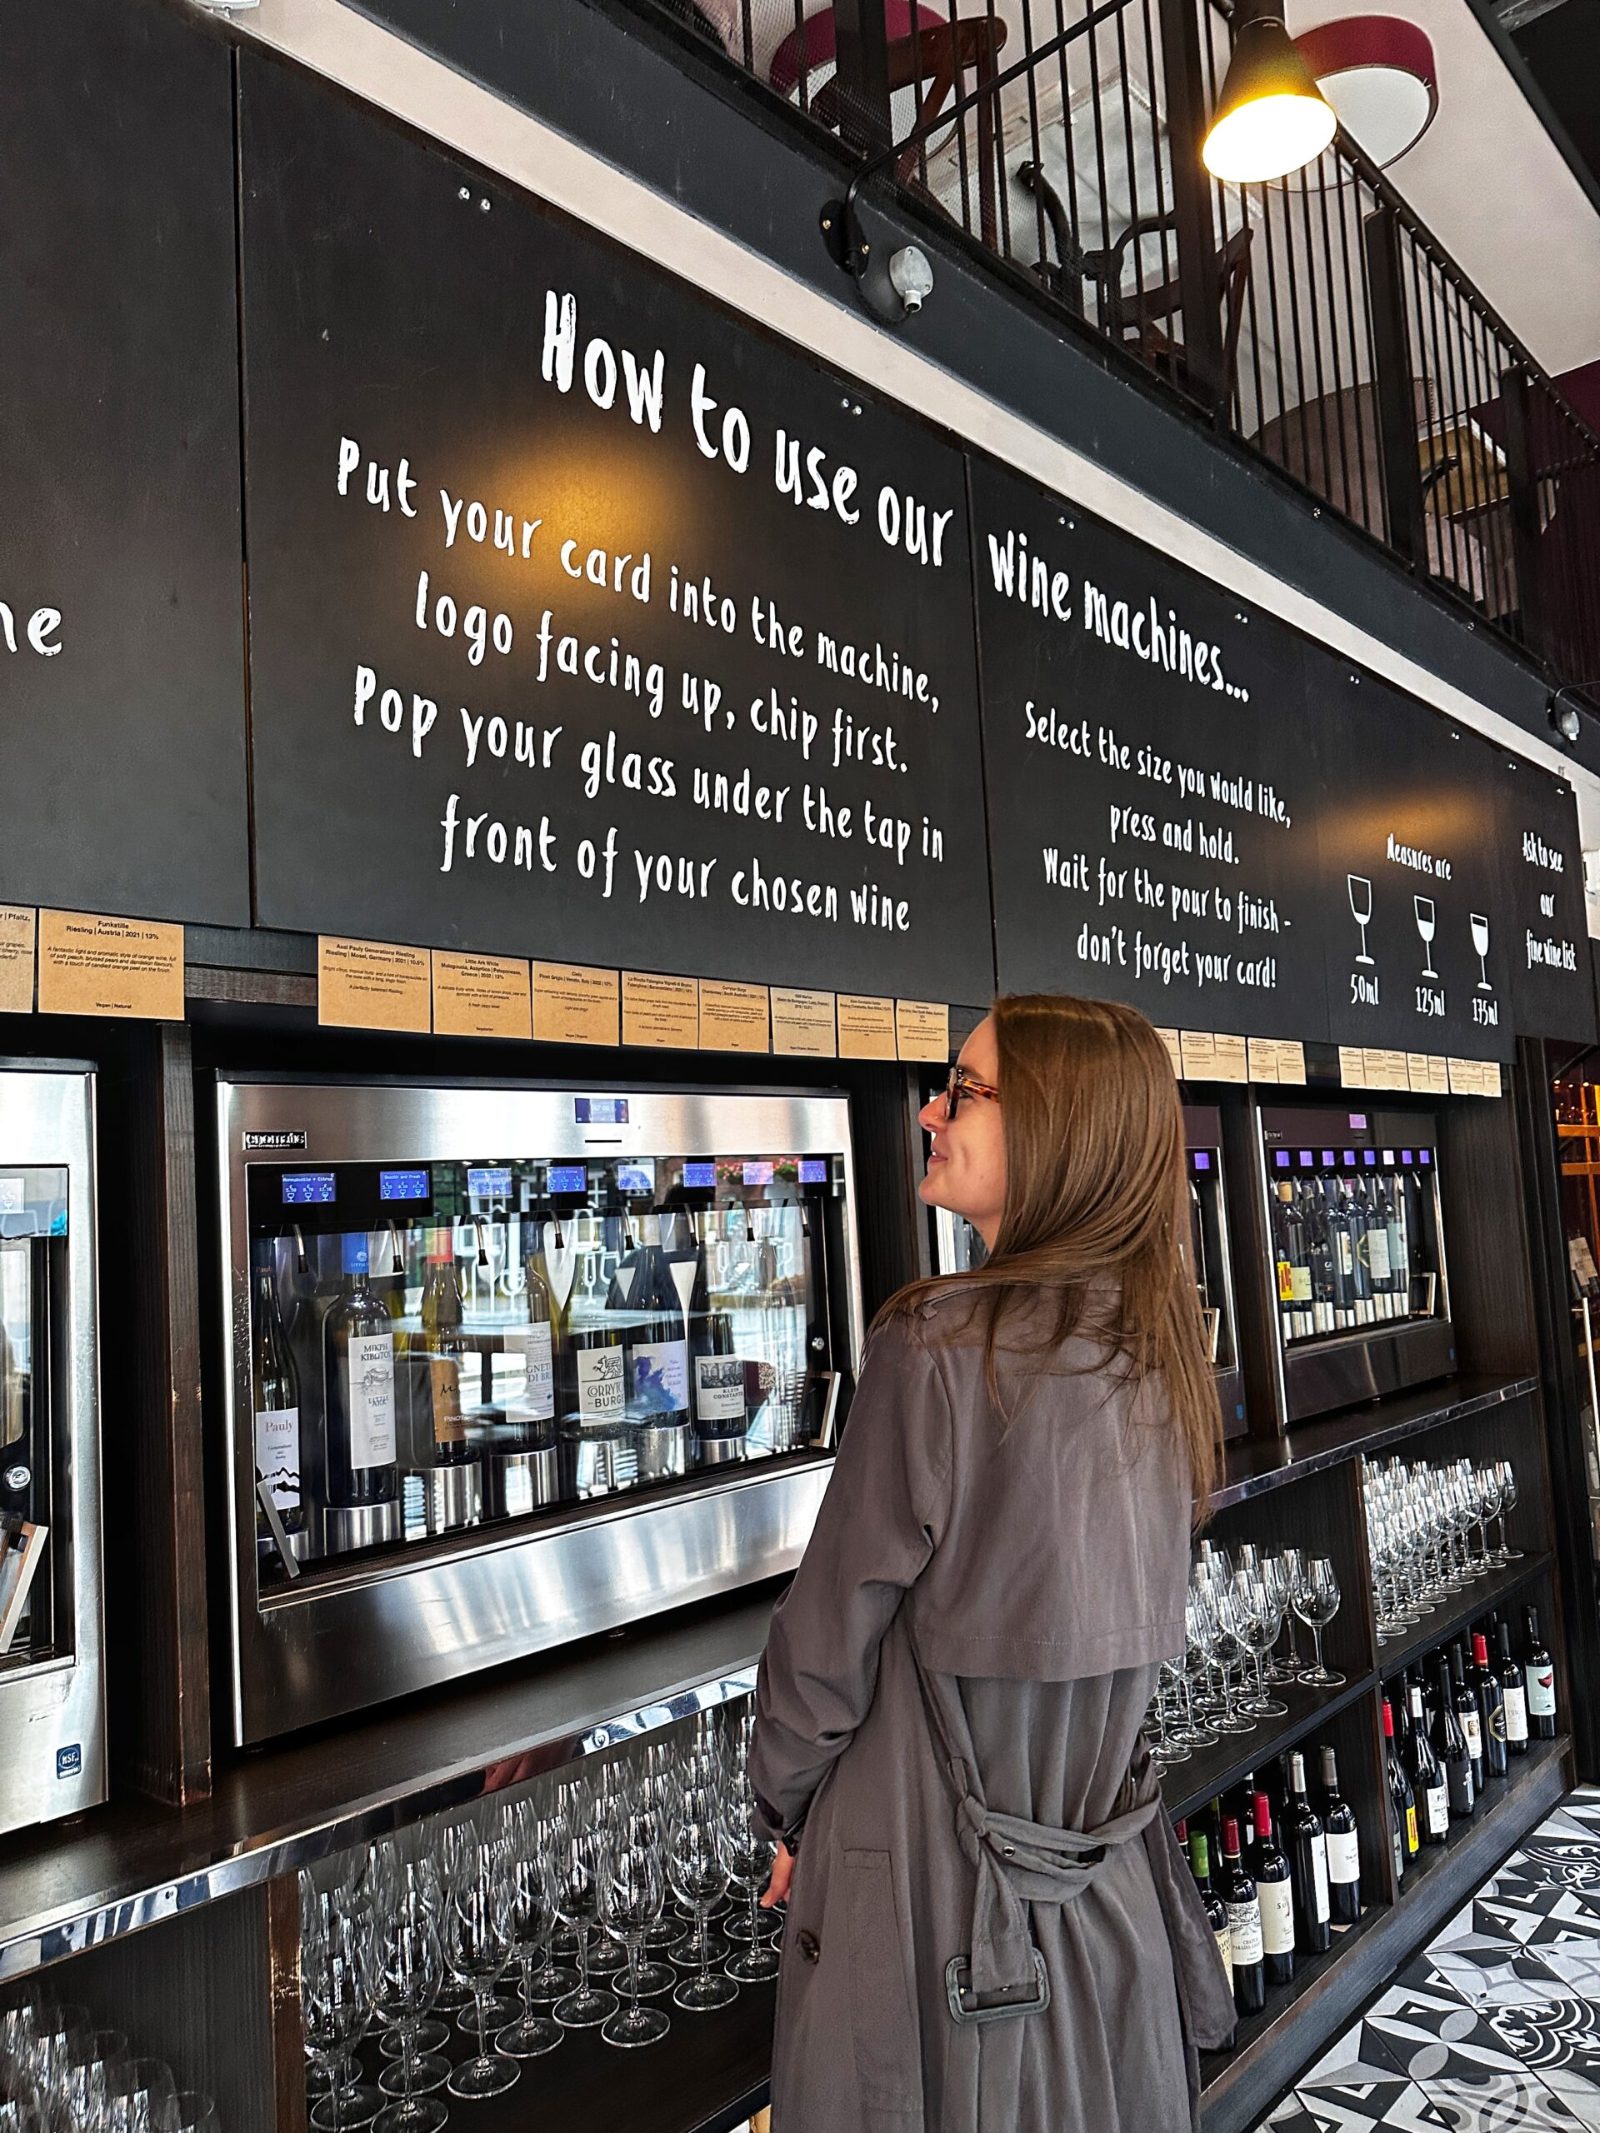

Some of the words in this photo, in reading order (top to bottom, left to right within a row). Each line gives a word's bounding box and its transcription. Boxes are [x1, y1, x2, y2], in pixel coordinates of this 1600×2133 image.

[541, 290, 665, 434] How
[691, 363, 751, 474] to
[775, 429, 860, 525] use
[877, 486, 954, 567] our
[987, 530, 1072, 622] wine
[1084, 580, 1249, 703] machines...
[337, 436, 417, 518] Put
[439, 489, 543, 560] your
[560, 539, 651, 603] card
[669, 565, 736, 634] into
[751, 595, 804, 658] the
[817, 632, 939, 714] machine,
[415, 570, 513, 667] logo
[535, 610, 664, 719] facing
[681, 672, 735, 732] up,
[750, 688, 818, 760] chip
[831, 707, 909, 773] first.
[353, 664, 438, 758] Pop
[459, 707, 563, 769] your
[580, 730, 677, 799] glass
[693, 768, 791, 823] under
[802, 784, 853, 839] the
[864, 800, 911, 866] tap
[923, 816, 943, 863] in
[1025, 700, 1092, 758] Select
[1098, 726, 1131, 771] the
[1137, 745, 1173, 785] size
[1177, 764, 1206, 799] you
[1210, 771, 1253, 812] would
[1258, 783, 1291, 829] like,
[439, 793, 558, 872] front
[577, 826, 619, 898] of
[633, 849, 717, 904] your
[731, 857, 838, 922] chosen
[850, 884, 910, 932] wine
[1110, 804, 1157, 842] press
[1162, 819, 1193, 853] and
[1199, 821, 1240, 865] hold.
[1386, 832, 1433, 874] Measures
[1435, 858, 1452, 881] are
[1522, 831, 1539, 866] Ask
[1537, 837, 1548, 868] to
[1548, 848, 1564, 873] see
[1042, 847, 1090, 892] Wait
[1097, 857, 1128, 906] for
[1134, 867, 1165, 908] the
[1171, 885, 1210, 922] pour
[1214, 886, 1232, 922] to
[1237, 890, 1280, 934] finish
[1540, 894, 1555, 918] our
[66, 925, 93, 935] Riesling
[1077, 922, 1127, 966] don't
[1134, 930, 1191, 985] forget
[1195, 952, 1232, 988] your
[1236, 956, 1276, 988] card!
[1526, 929, 1544, 969] fine
[1543, 938, 1563, 968] wine
[1562, 940, 1577, 972] list
[1350, 973, 1379, 1006] 50ml
[1415, 986, 1446, 1017] 125ml
[1471, 997, 1499, 1026] 175ml
[265, 1419, 293, 1433] Pauly
[62, 1752, 76, 1765] NSF
